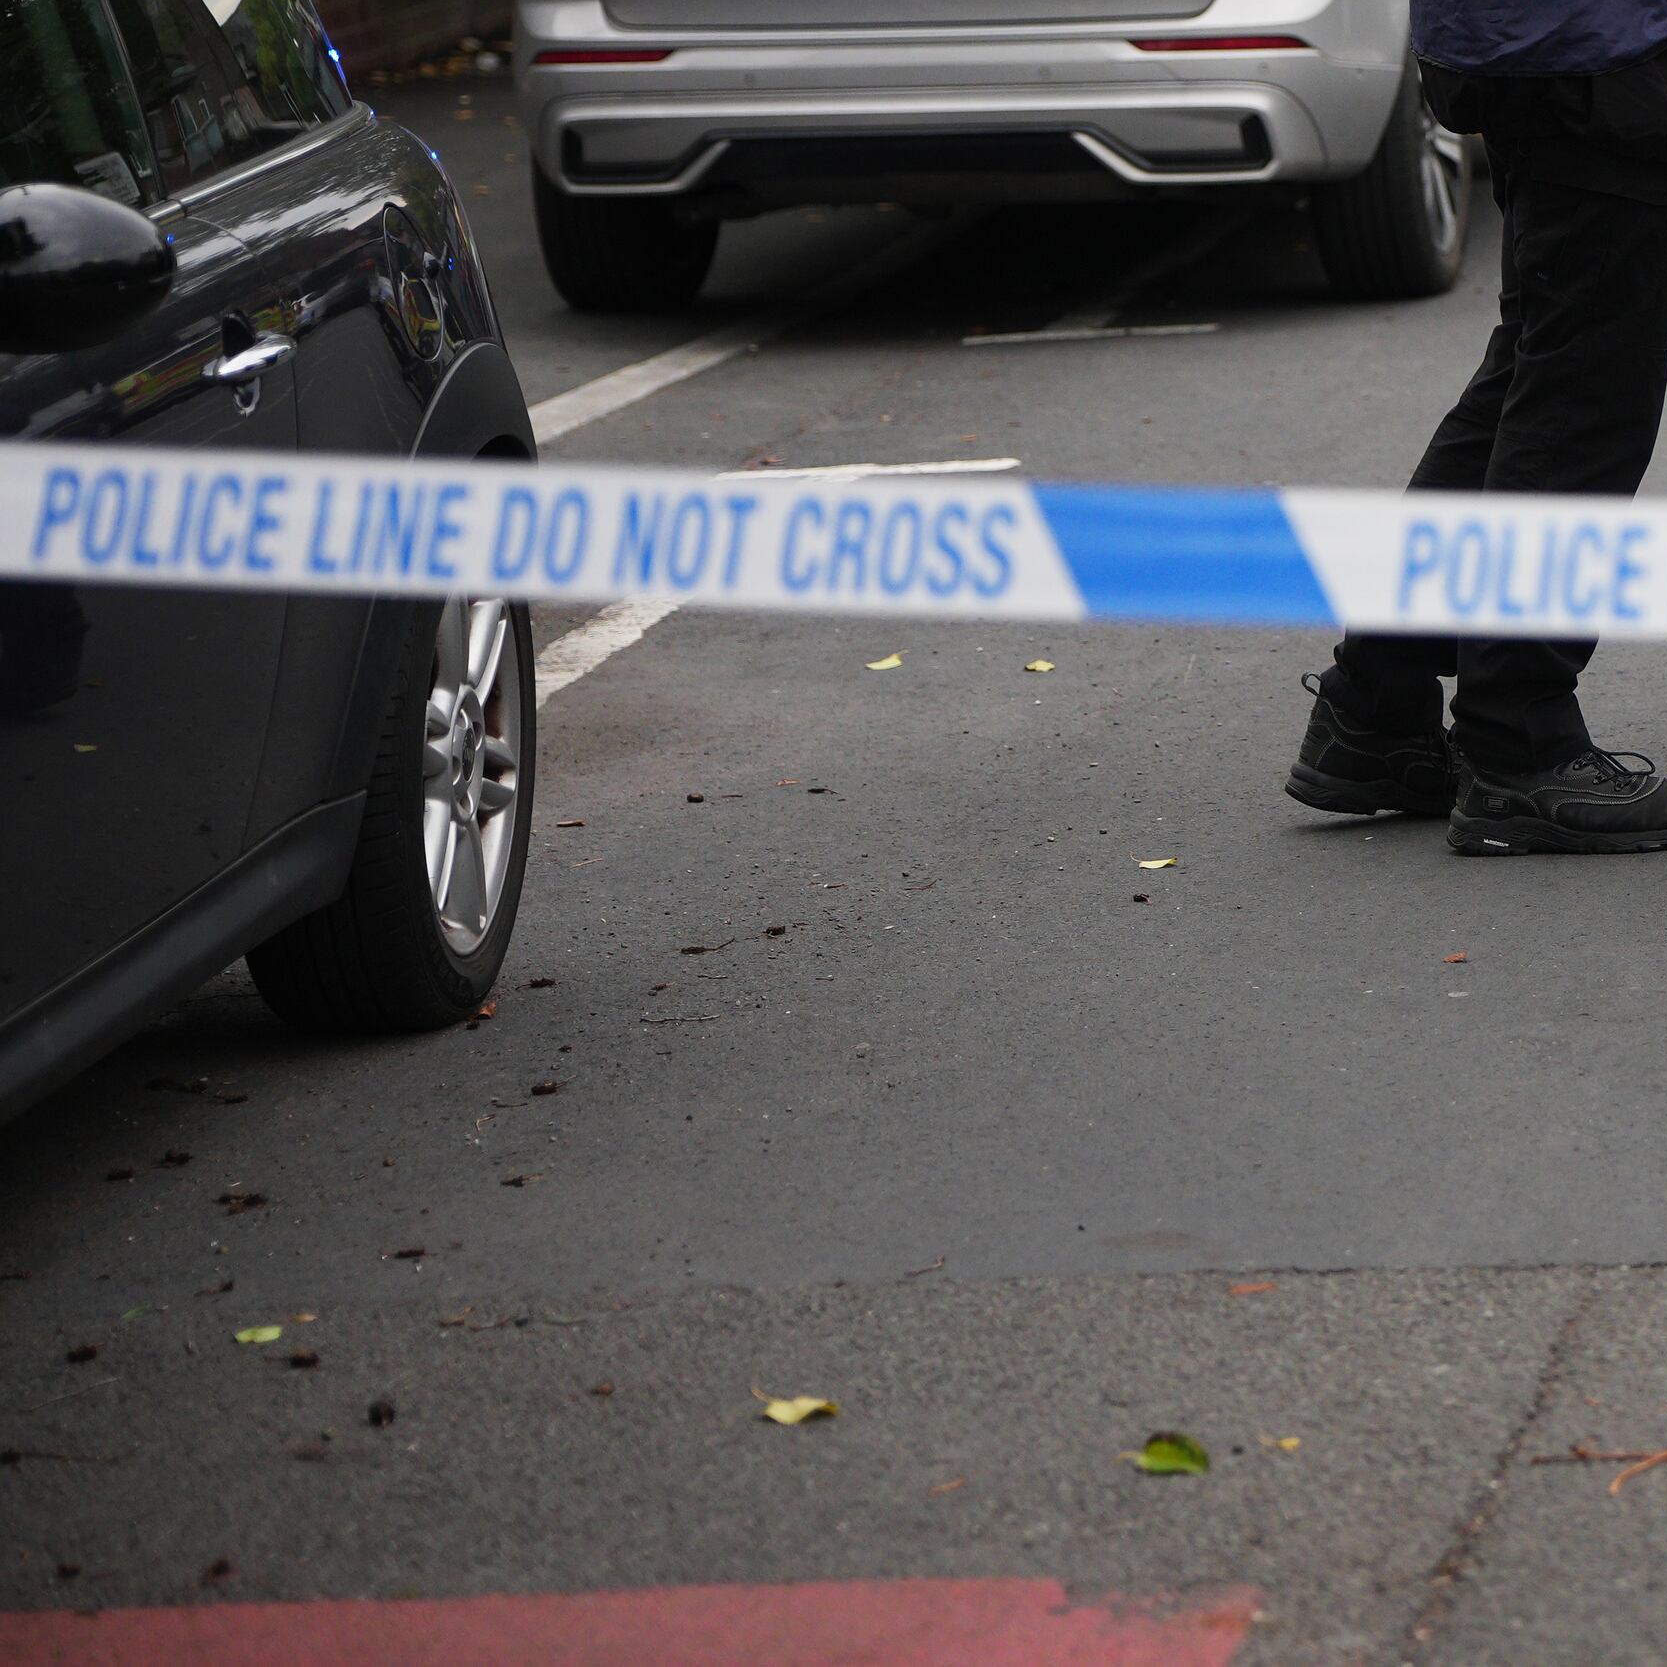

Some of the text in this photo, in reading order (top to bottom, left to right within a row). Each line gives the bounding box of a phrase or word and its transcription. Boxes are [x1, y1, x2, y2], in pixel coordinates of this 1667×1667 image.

[34, 466, 1018, 598] POLICE LINE DO NOT CROSS
[1398, 520, 1648, 620] POLICE
